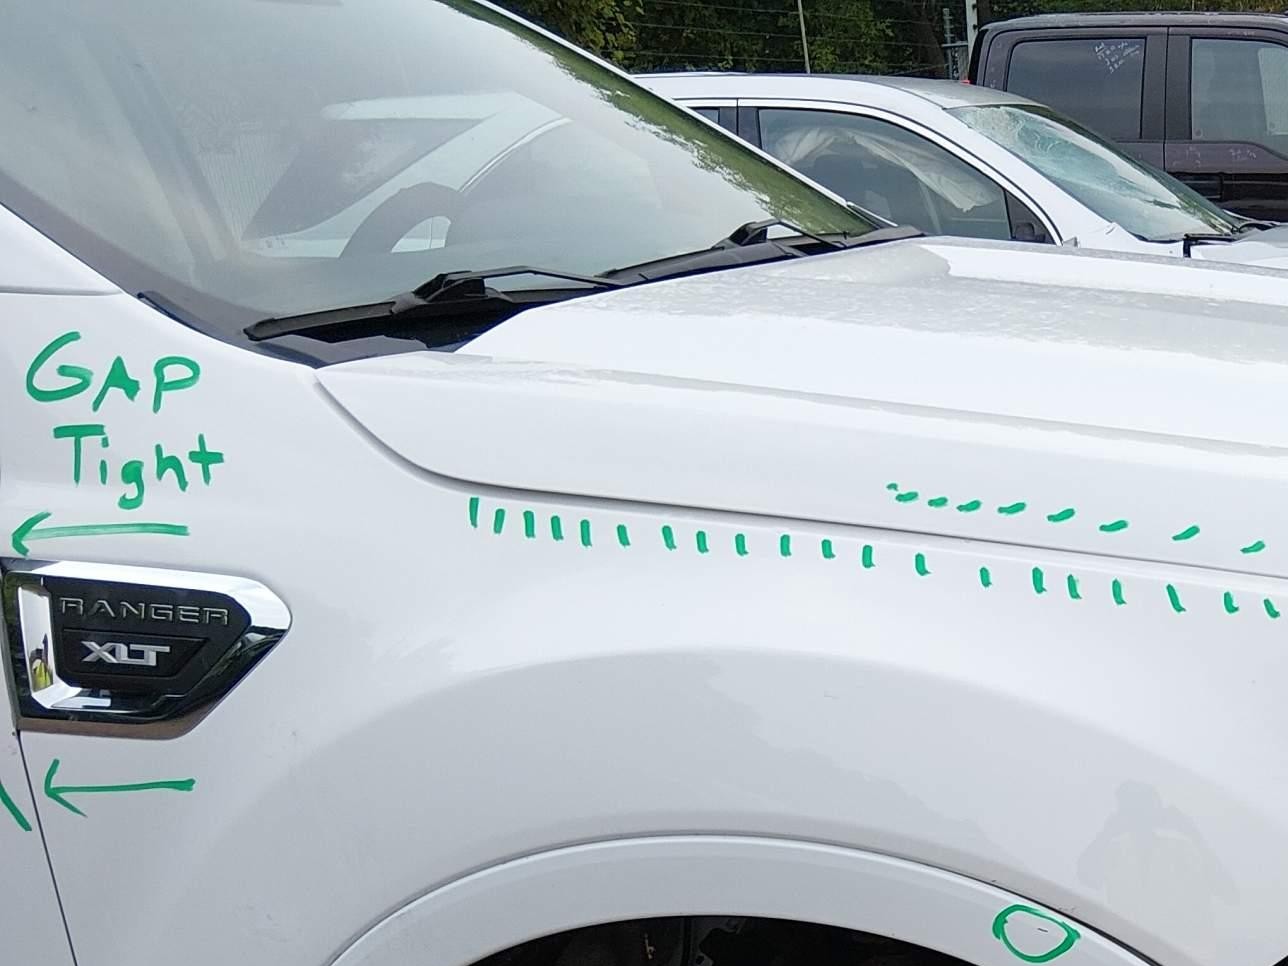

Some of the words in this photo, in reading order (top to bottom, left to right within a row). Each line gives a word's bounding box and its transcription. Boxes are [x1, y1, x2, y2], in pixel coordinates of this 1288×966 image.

[26, 331, 201, 413] GAP
[53, 424, 224, 510] Tight
[59, 597, 229, 626] RANGER
[81, 640, 171, 667] XLT
